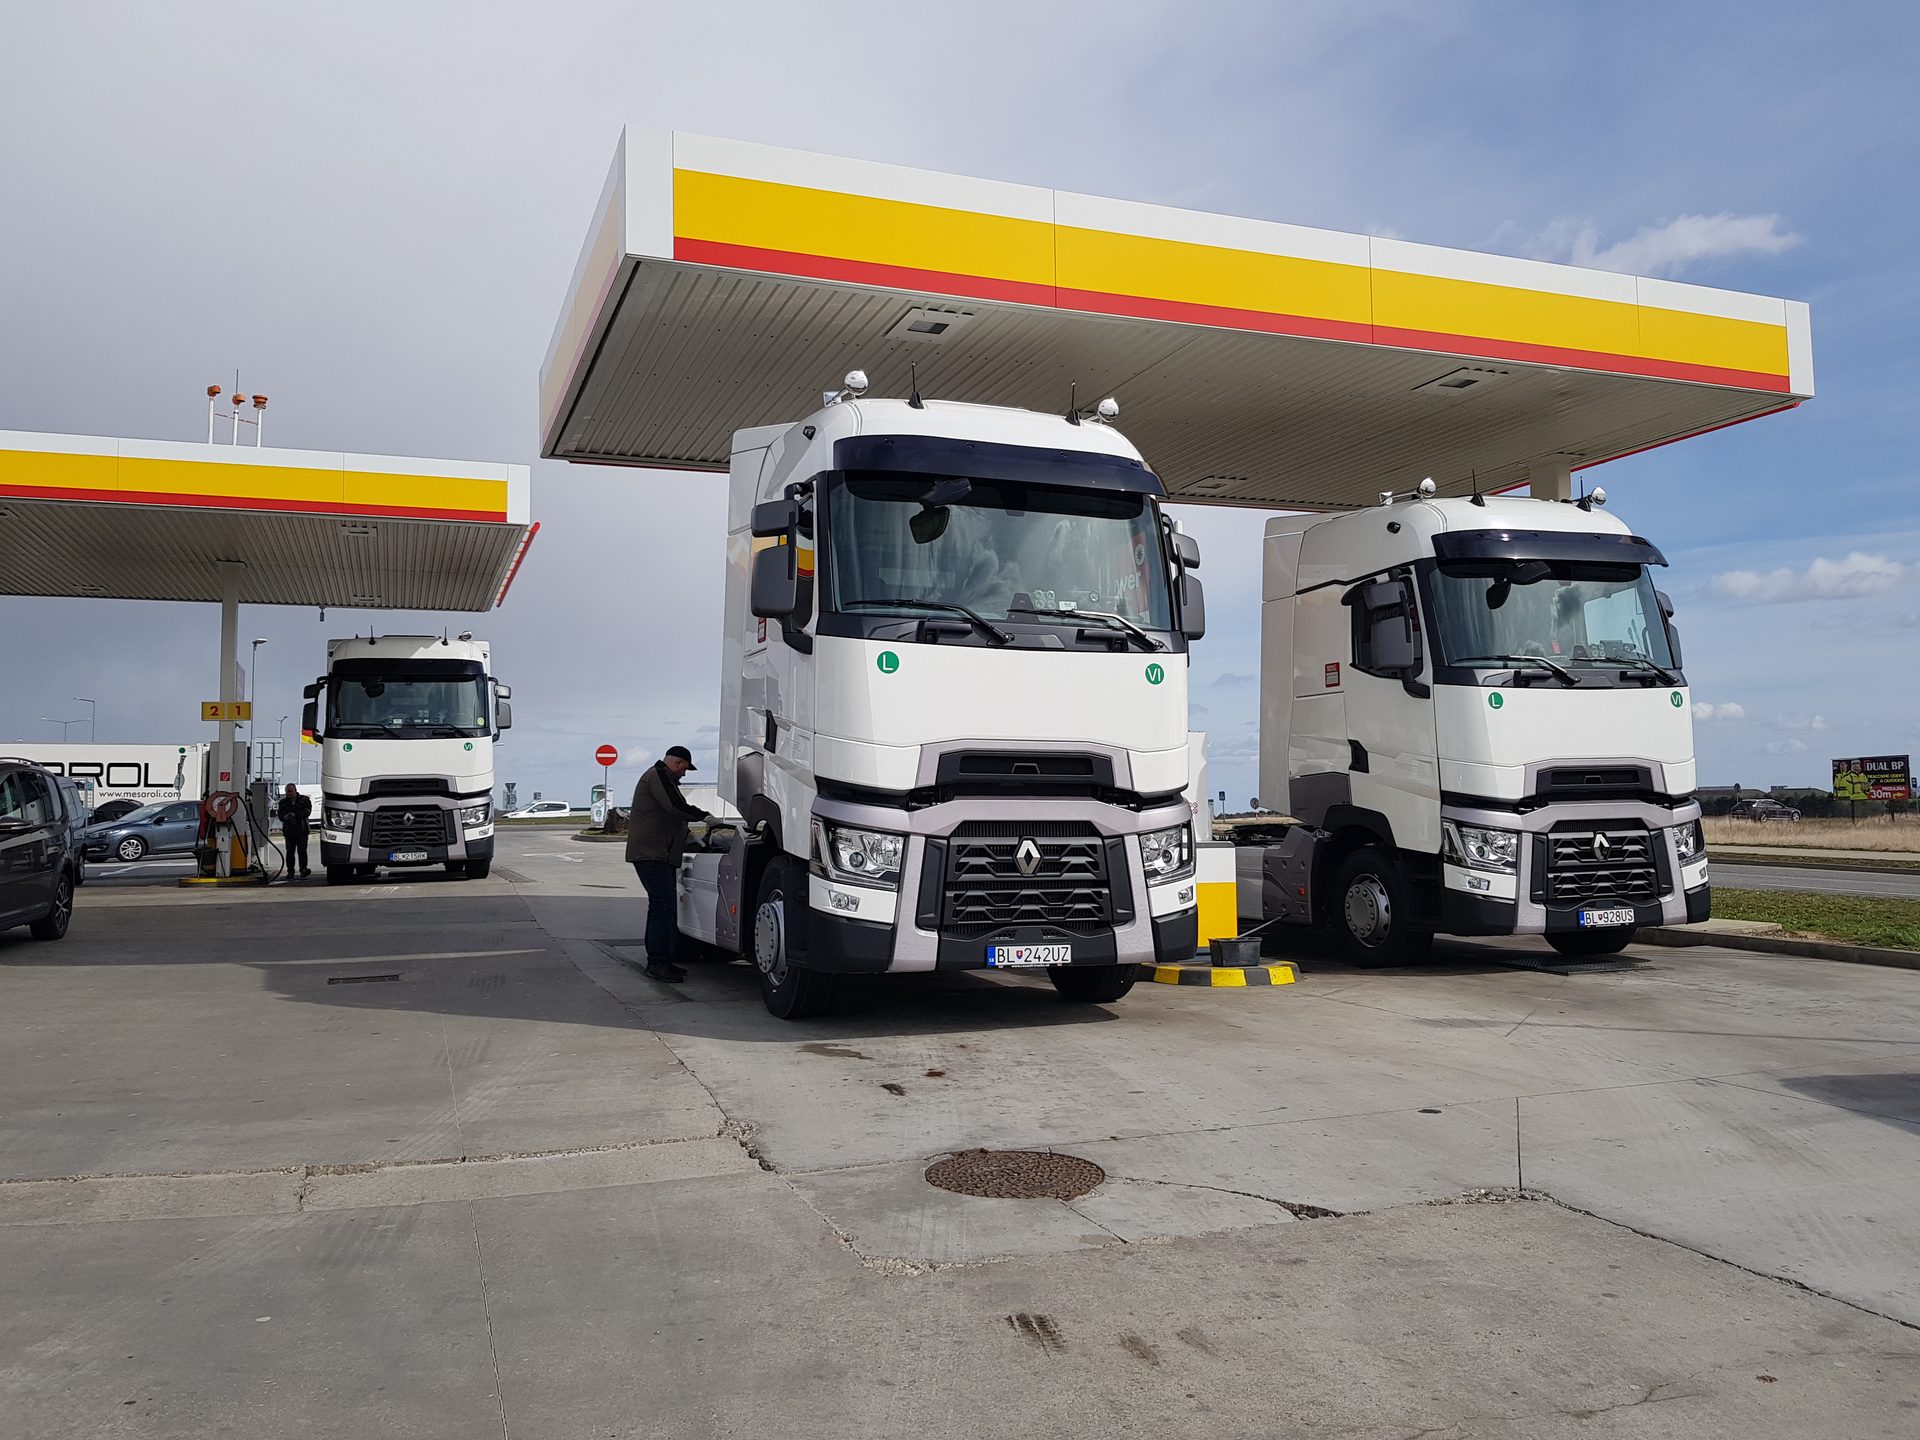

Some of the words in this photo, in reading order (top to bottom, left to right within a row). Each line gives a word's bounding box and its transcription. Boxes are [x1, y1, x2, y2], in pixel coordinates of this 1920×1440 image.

[883, 655, 893, 670] L
[1147, 668, 1161, 681] VI
[1491, 695, 1500, 707] L
[1671, 694, 1681, 706] VI
[210, 706, 219, 717] 2
[1866, 762, 1890, 771] DUAL
[1891, 761, 1904, 770] BP
[99, 790, 182, 798] www.mesaroli.com
[1871, 789, 1892, 798] 30m
[1585, 912, 1599, 924] BL
[1603, 910, 1633, 923] 928US
[997, 948, 1015, 963] BL
[1024, 947, 1069, 963] 242UZ
